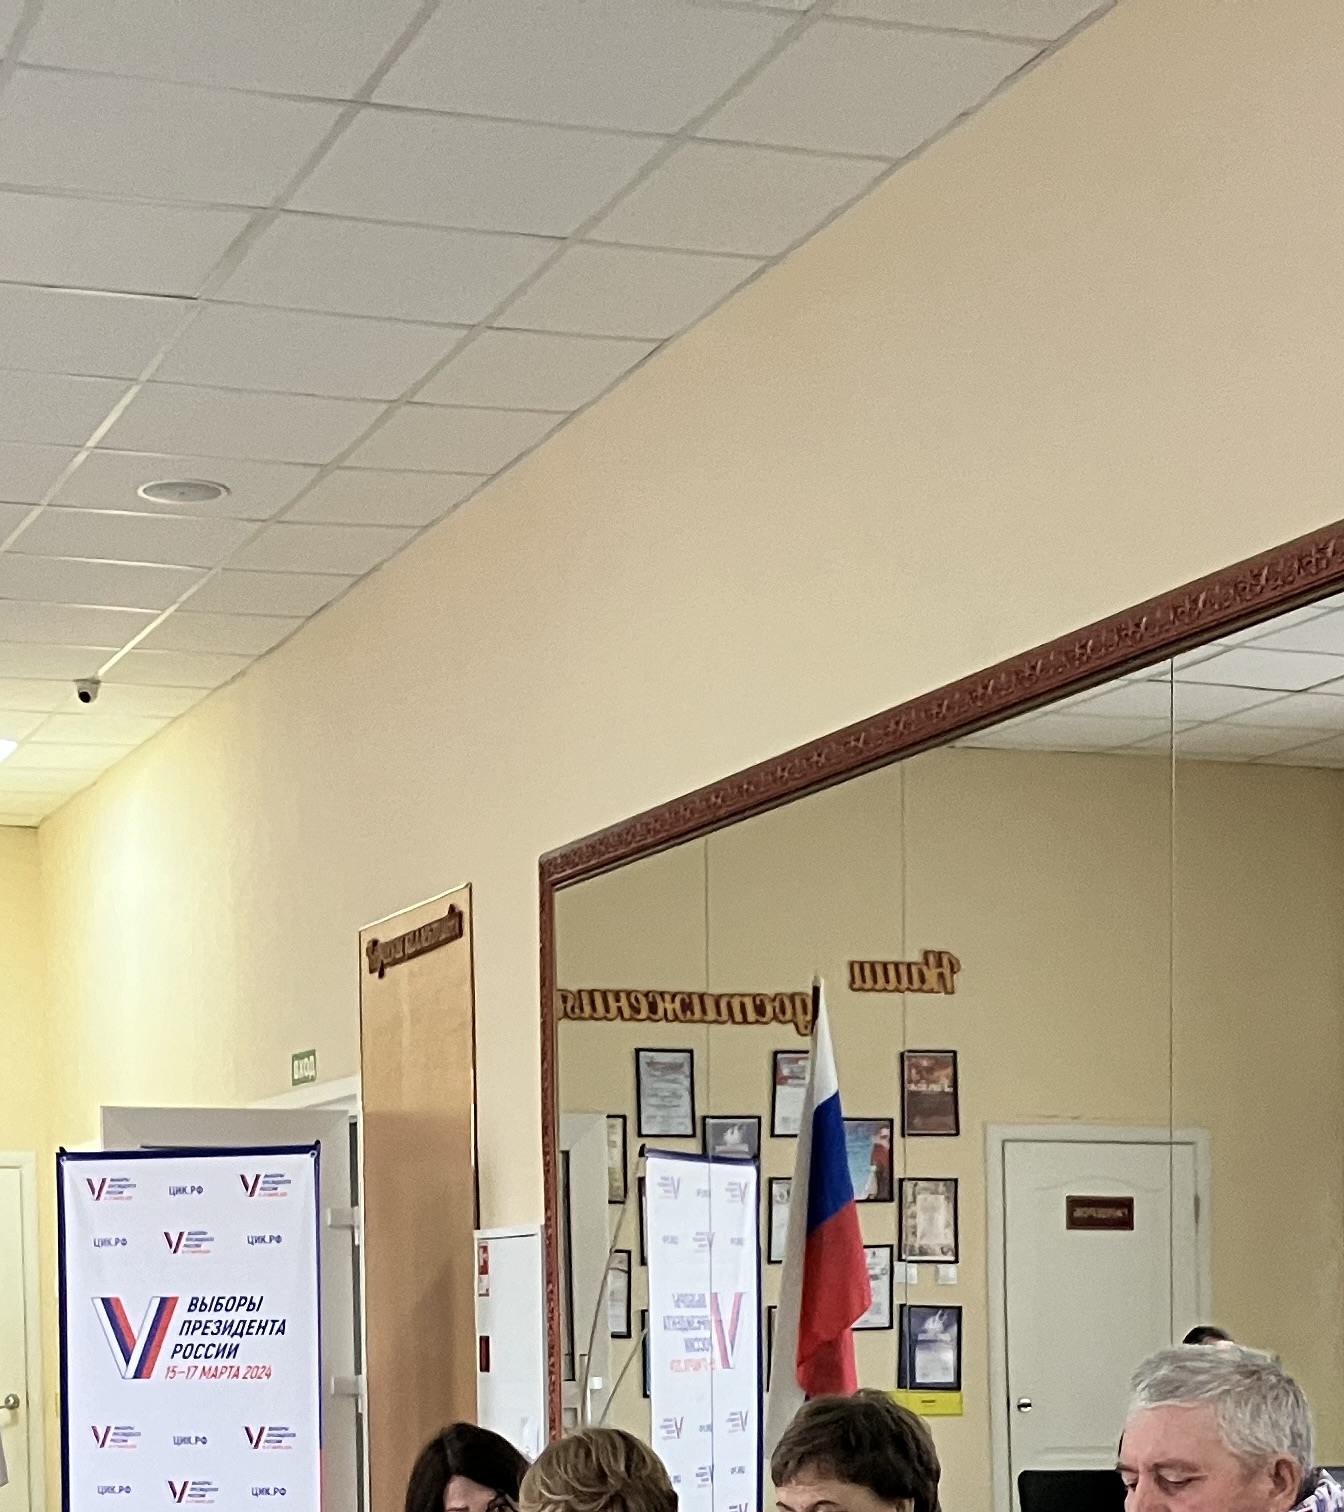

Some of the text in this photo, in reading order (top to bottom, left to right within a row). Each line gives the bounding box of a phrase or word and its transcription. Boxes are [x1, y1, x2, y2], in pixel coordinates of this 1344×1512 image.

[187, 1296, 264, 1313] ВЫБОРЫ
[178, 1319, 286, 1338] ПРЕЗИДЕНТА
[170, 1343, 240, 1360] РОССИИ
[199, 1365, 240, 1380] МАРТА
[242, 1365, 273, 1380] 2024
